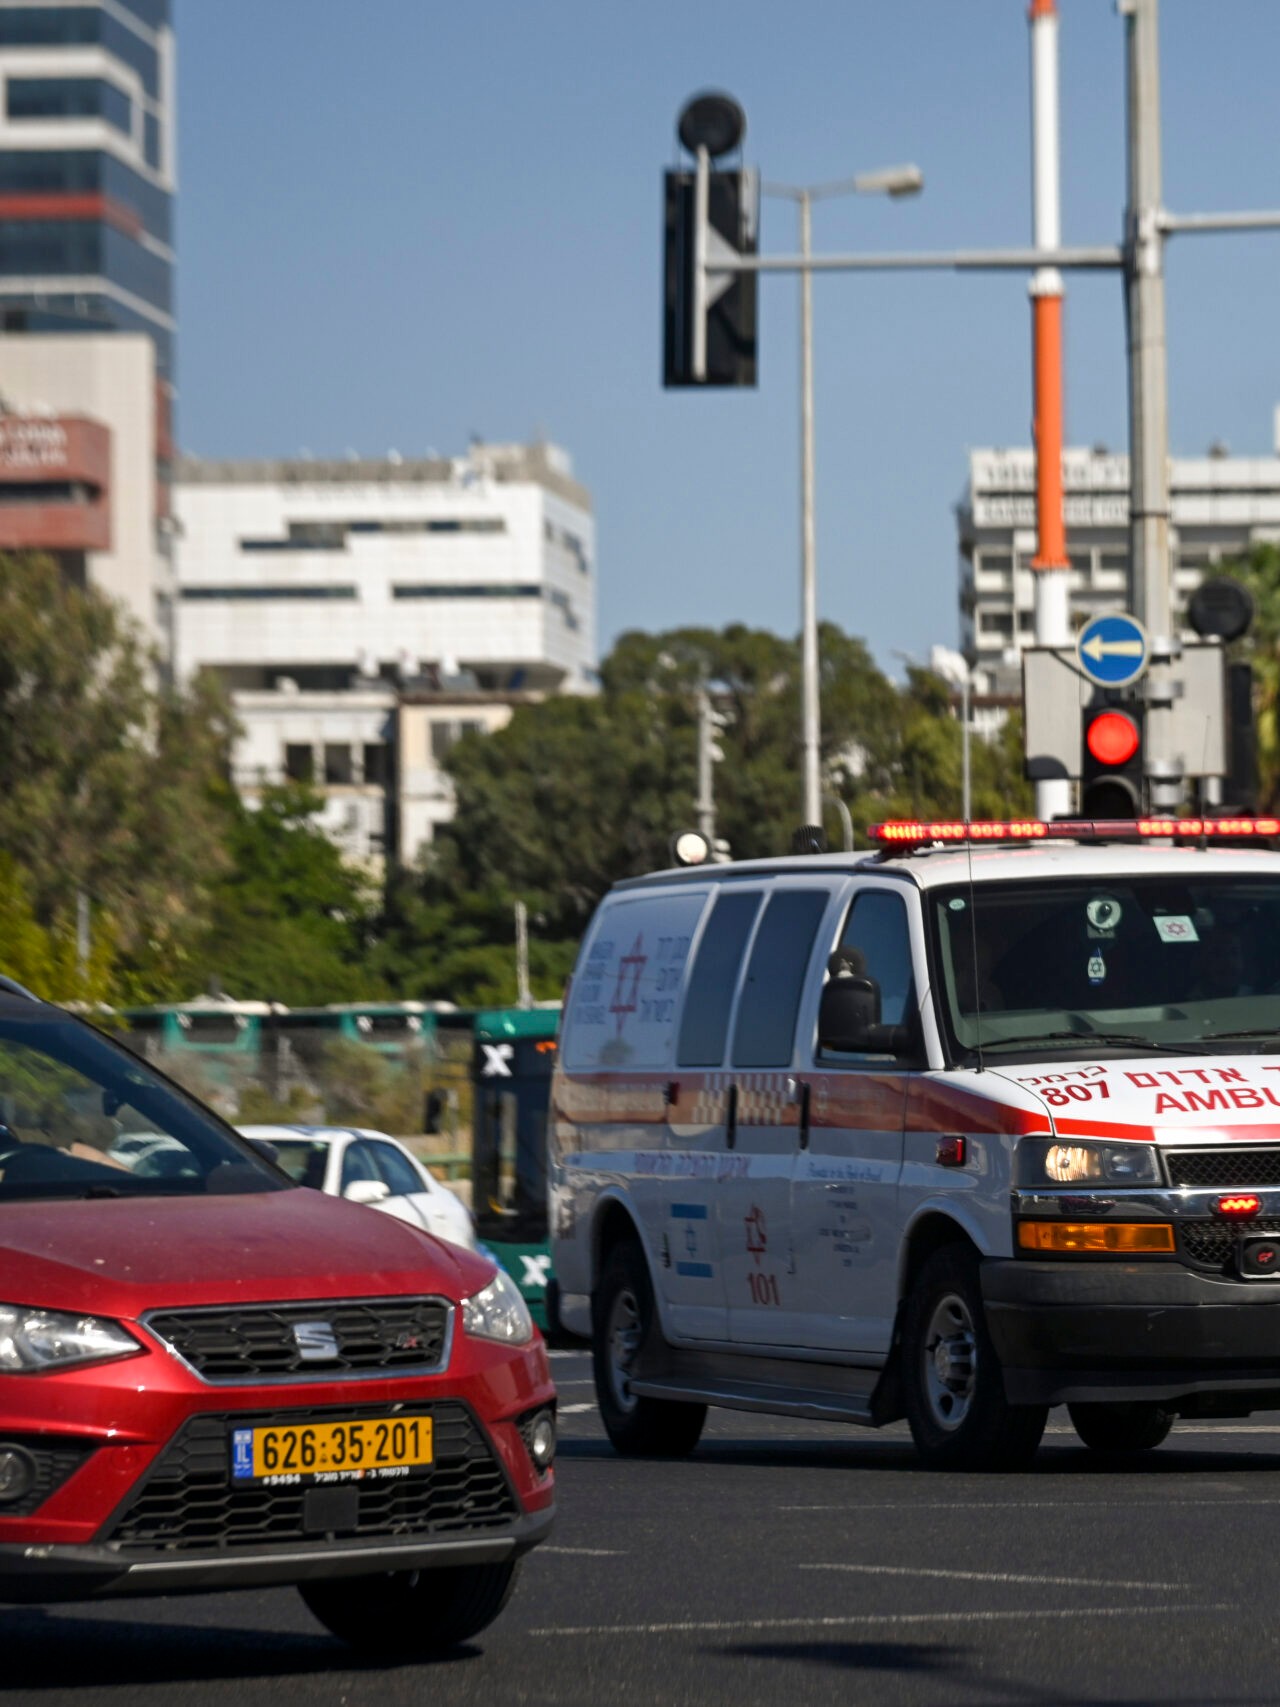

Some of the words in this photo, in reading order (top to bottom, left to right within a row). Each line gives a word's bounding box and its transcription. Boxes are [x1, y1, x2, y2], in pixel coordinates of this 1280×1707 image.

[1123, 1067, 1249, 1089] אדום
[1040, 1079, 1110, 1107] 807
[749, 1272, 780, 1306] 101
